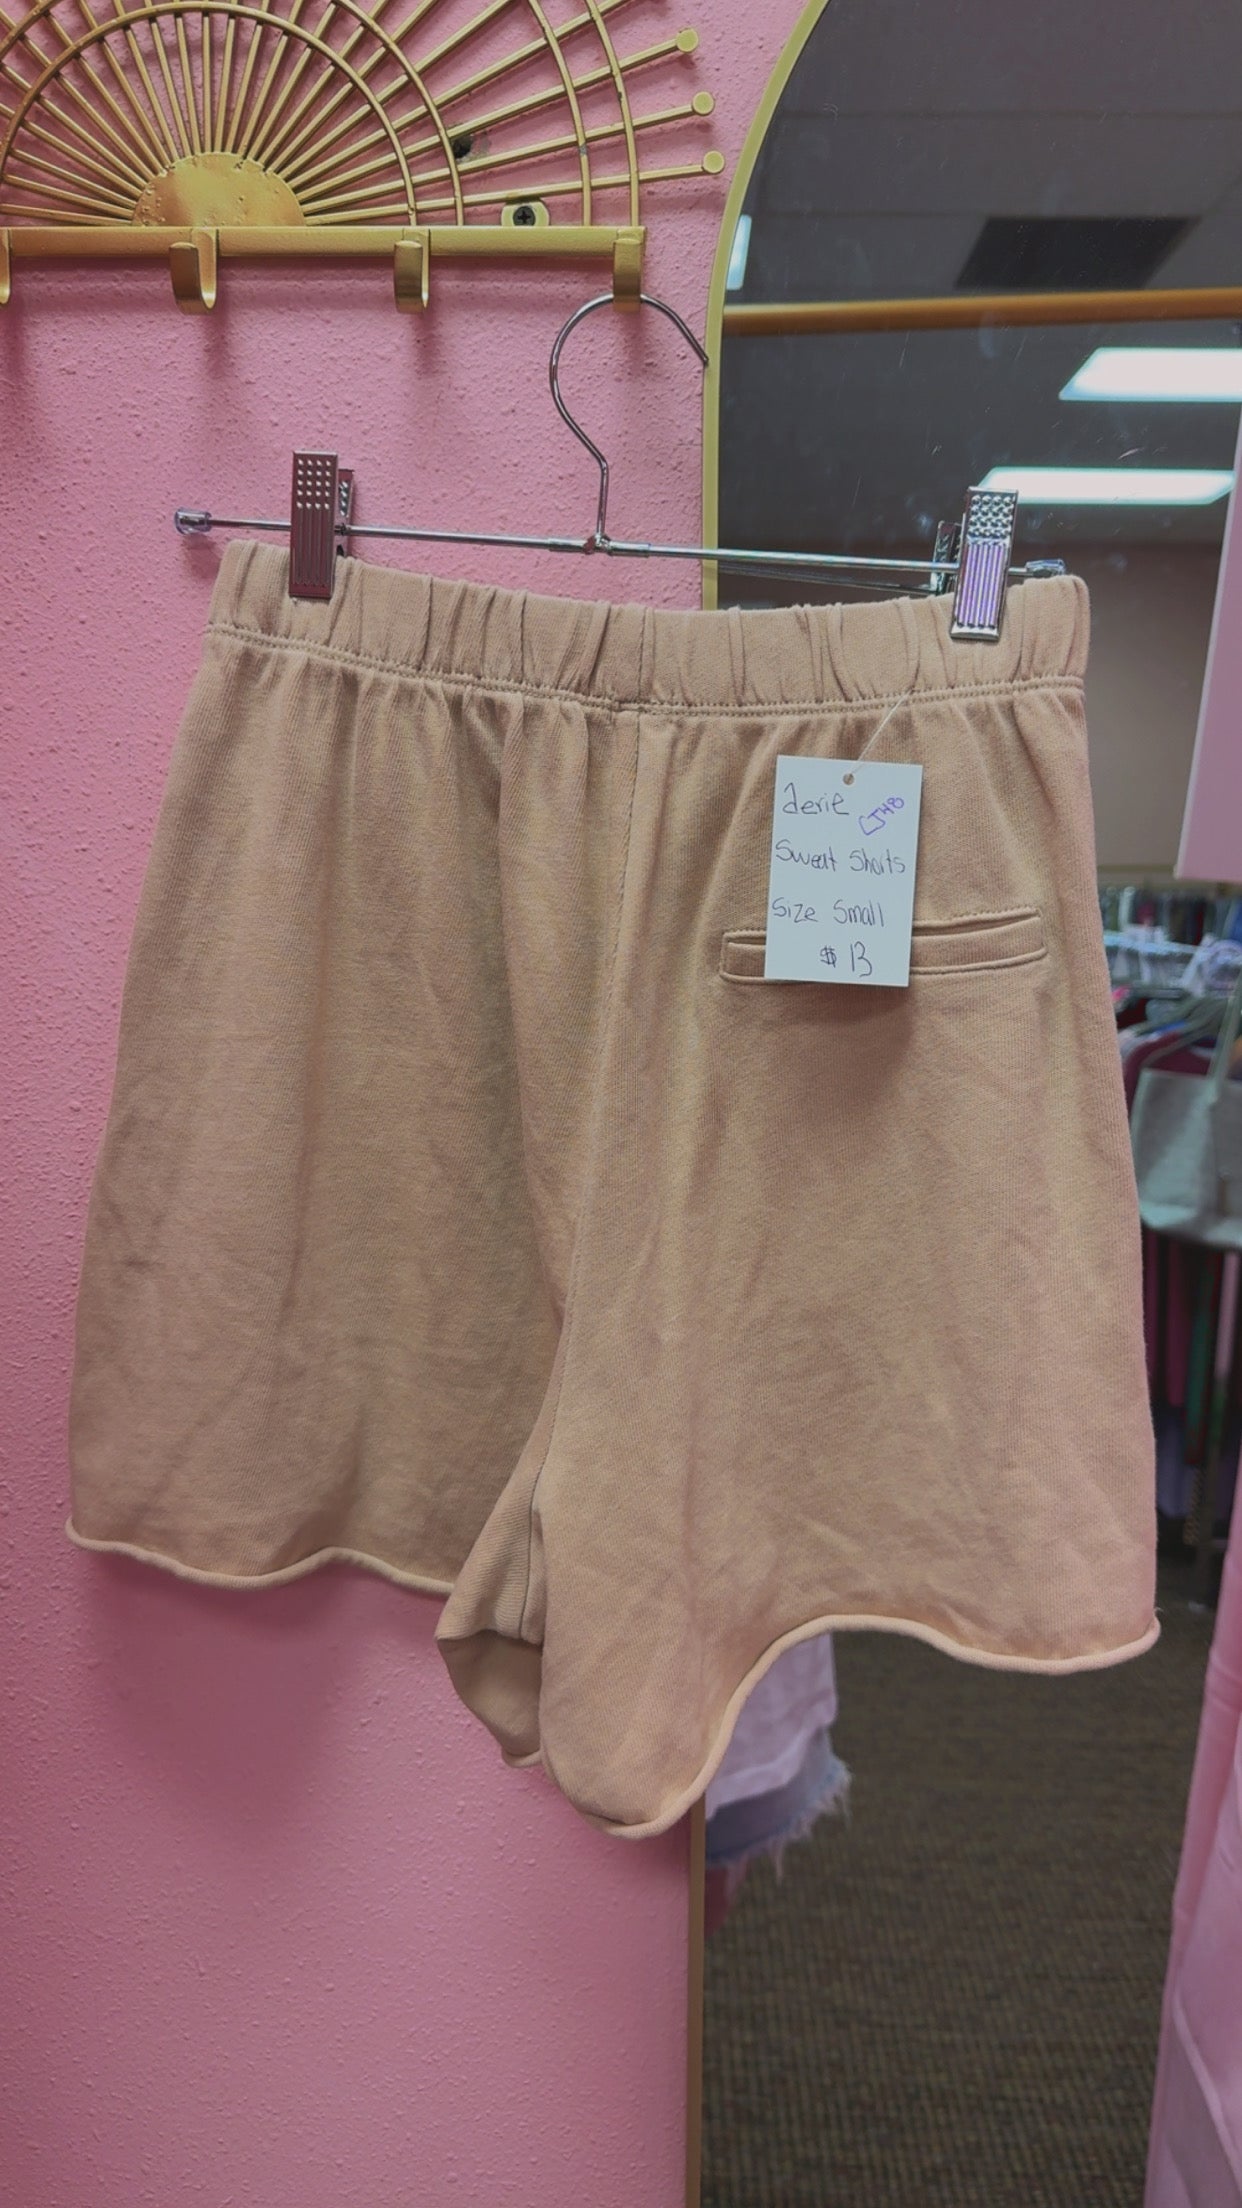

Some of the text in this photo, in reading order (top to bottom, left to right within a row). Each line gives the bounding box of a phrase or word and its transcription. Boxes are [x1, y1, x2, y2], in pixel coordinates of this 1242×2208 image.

[775, 838, 906, 875] Sweat Shorts
[771, 897, 885, 927] Size Small
